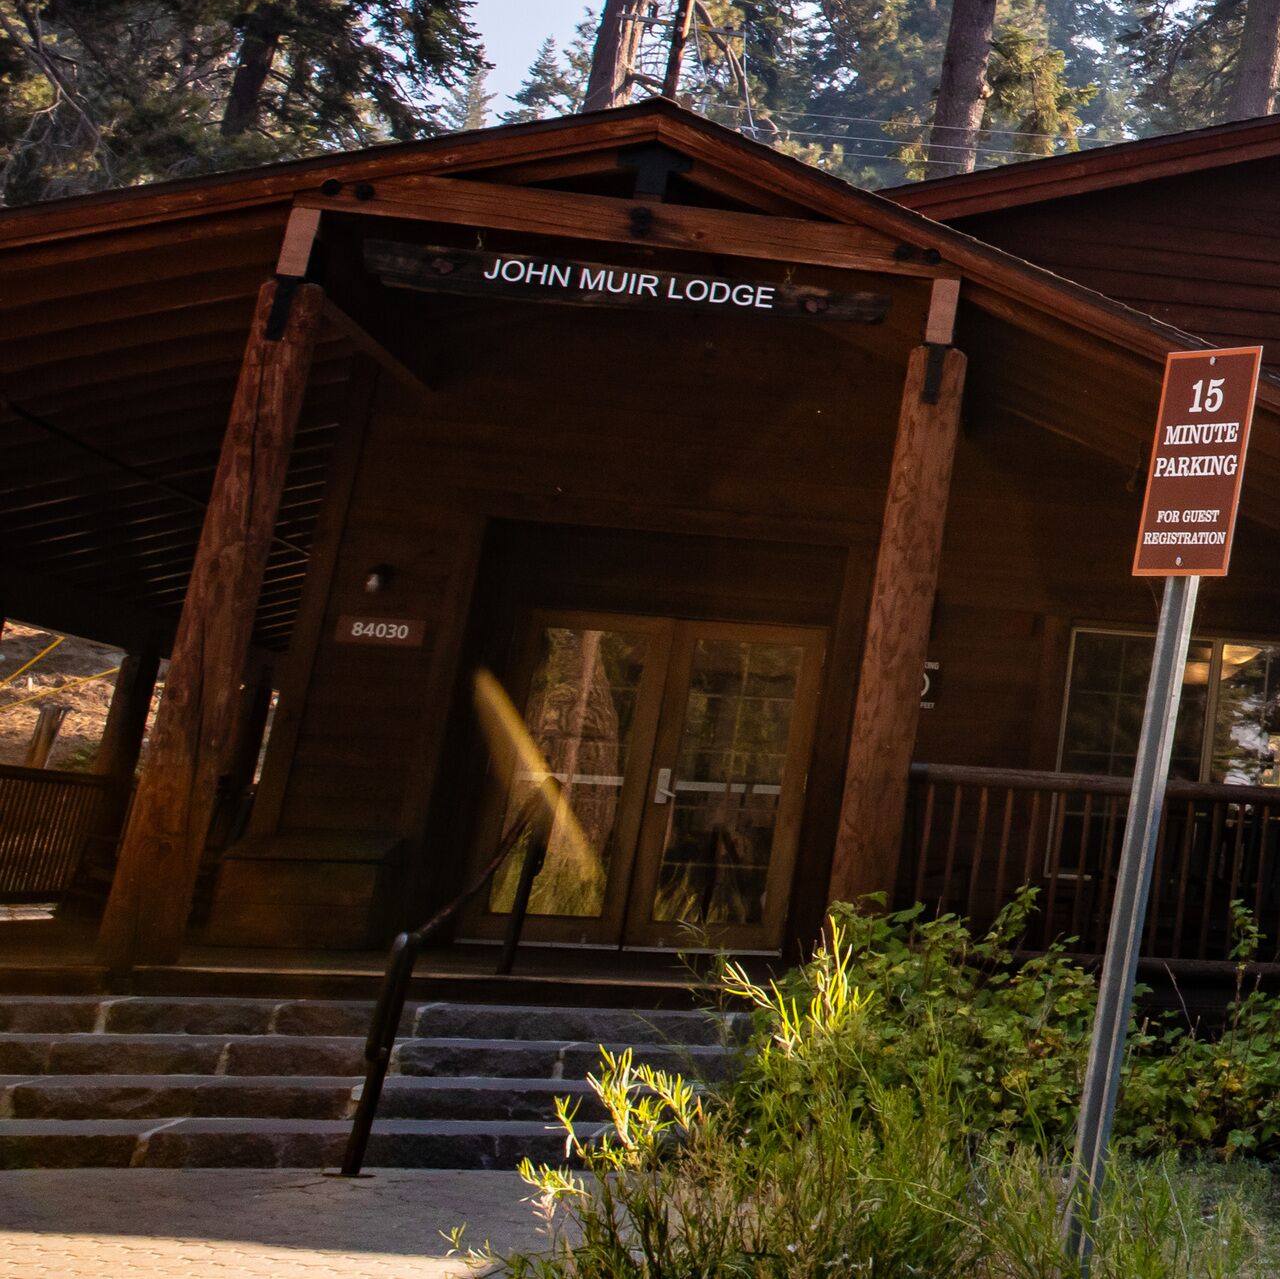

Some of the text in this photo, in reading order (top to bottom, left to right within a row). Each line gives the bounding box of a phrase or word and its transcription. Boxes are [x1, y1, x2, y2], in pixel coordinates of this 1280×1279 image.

[483, 258, 776, 309] JOHN MUIR LODGE
[1188, 377, 1226, 413] 15
[1163, 422, 1240, 446] MINUTE
[1153, 454, 1238, 478] PARKING
[1156, 509, 1220, 524] FOR GUEST
[1143, 531, 1227, 545] REGISTRATION
[351, 621, 409, 640] 84030
